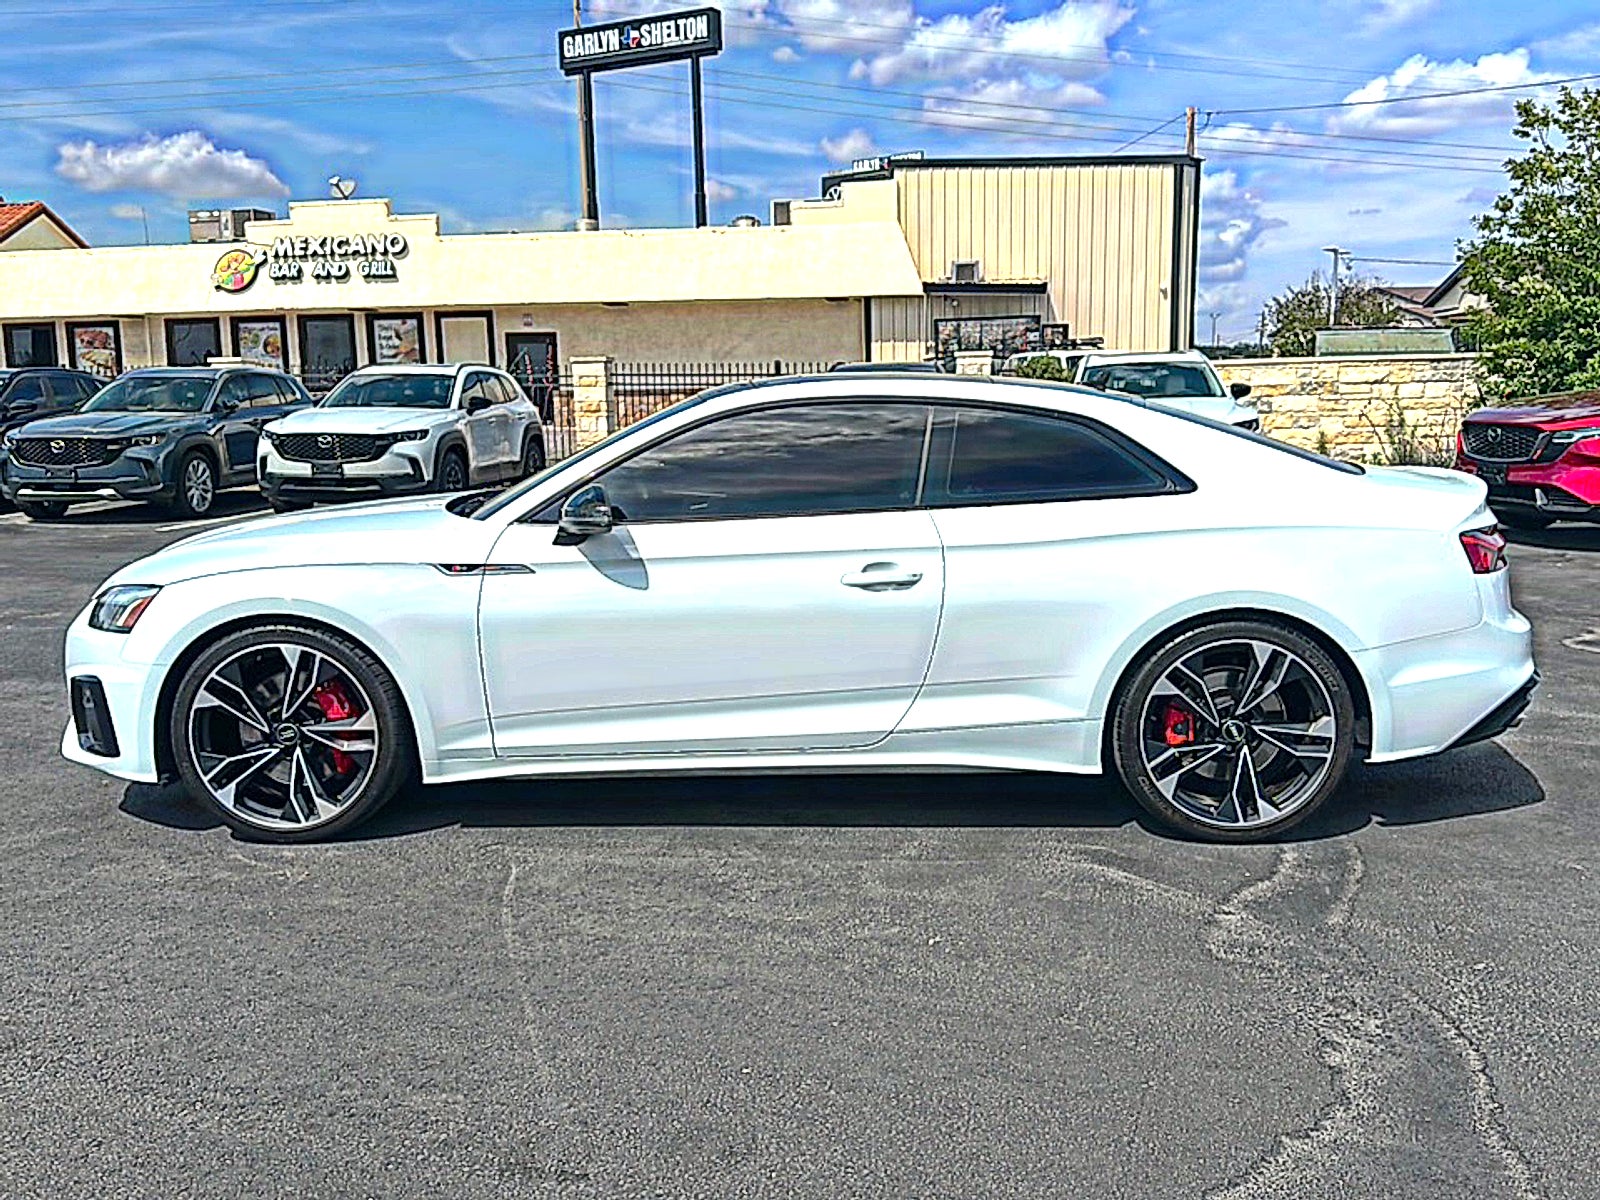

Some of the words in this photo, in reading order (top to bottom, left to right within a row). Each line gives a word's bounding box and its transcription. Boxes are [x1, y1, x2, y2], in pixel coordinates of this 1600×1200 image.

[563, 28, 620, 58] GARLYN
[640, 14, 708, 46] SHELTON
[271, 232, 407, 260] MEXICANO
[269, 261, 302, 279] BAR
[312, 260, 349, 279] AND
[357, 259, 396, 277] GRILL
